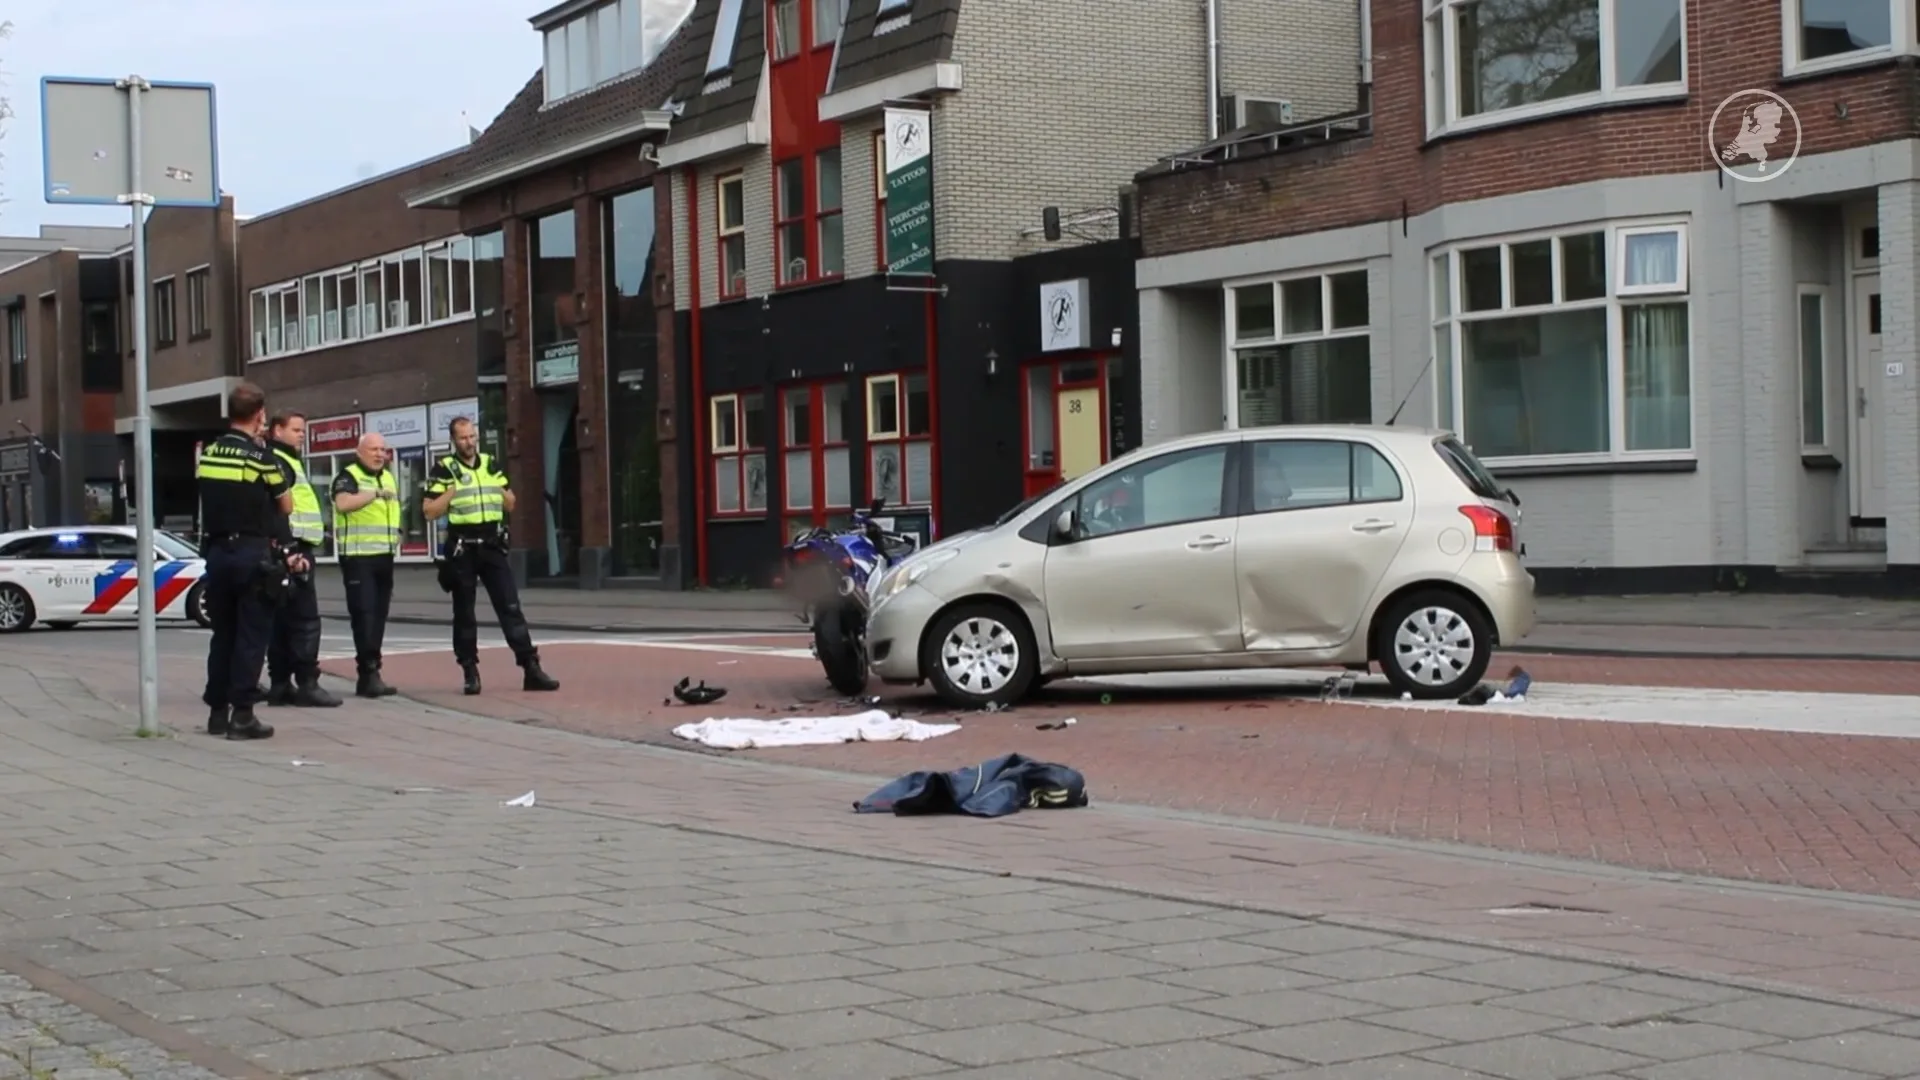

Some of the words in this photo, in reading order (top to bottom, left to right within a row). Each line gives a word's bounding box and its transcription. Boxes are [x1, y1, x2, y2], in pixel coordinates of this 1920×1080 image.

[890, 166, 927, 188] TATTOOS
[889, 201, 930, 226] PIERCINGS
[891, 214, 928, 238] TATTOOS
[889, 246, 930, 272] PIERCINGS
[1069, 399, 1081, 413] 38
[48, 572, 89, 588] POLITIE
